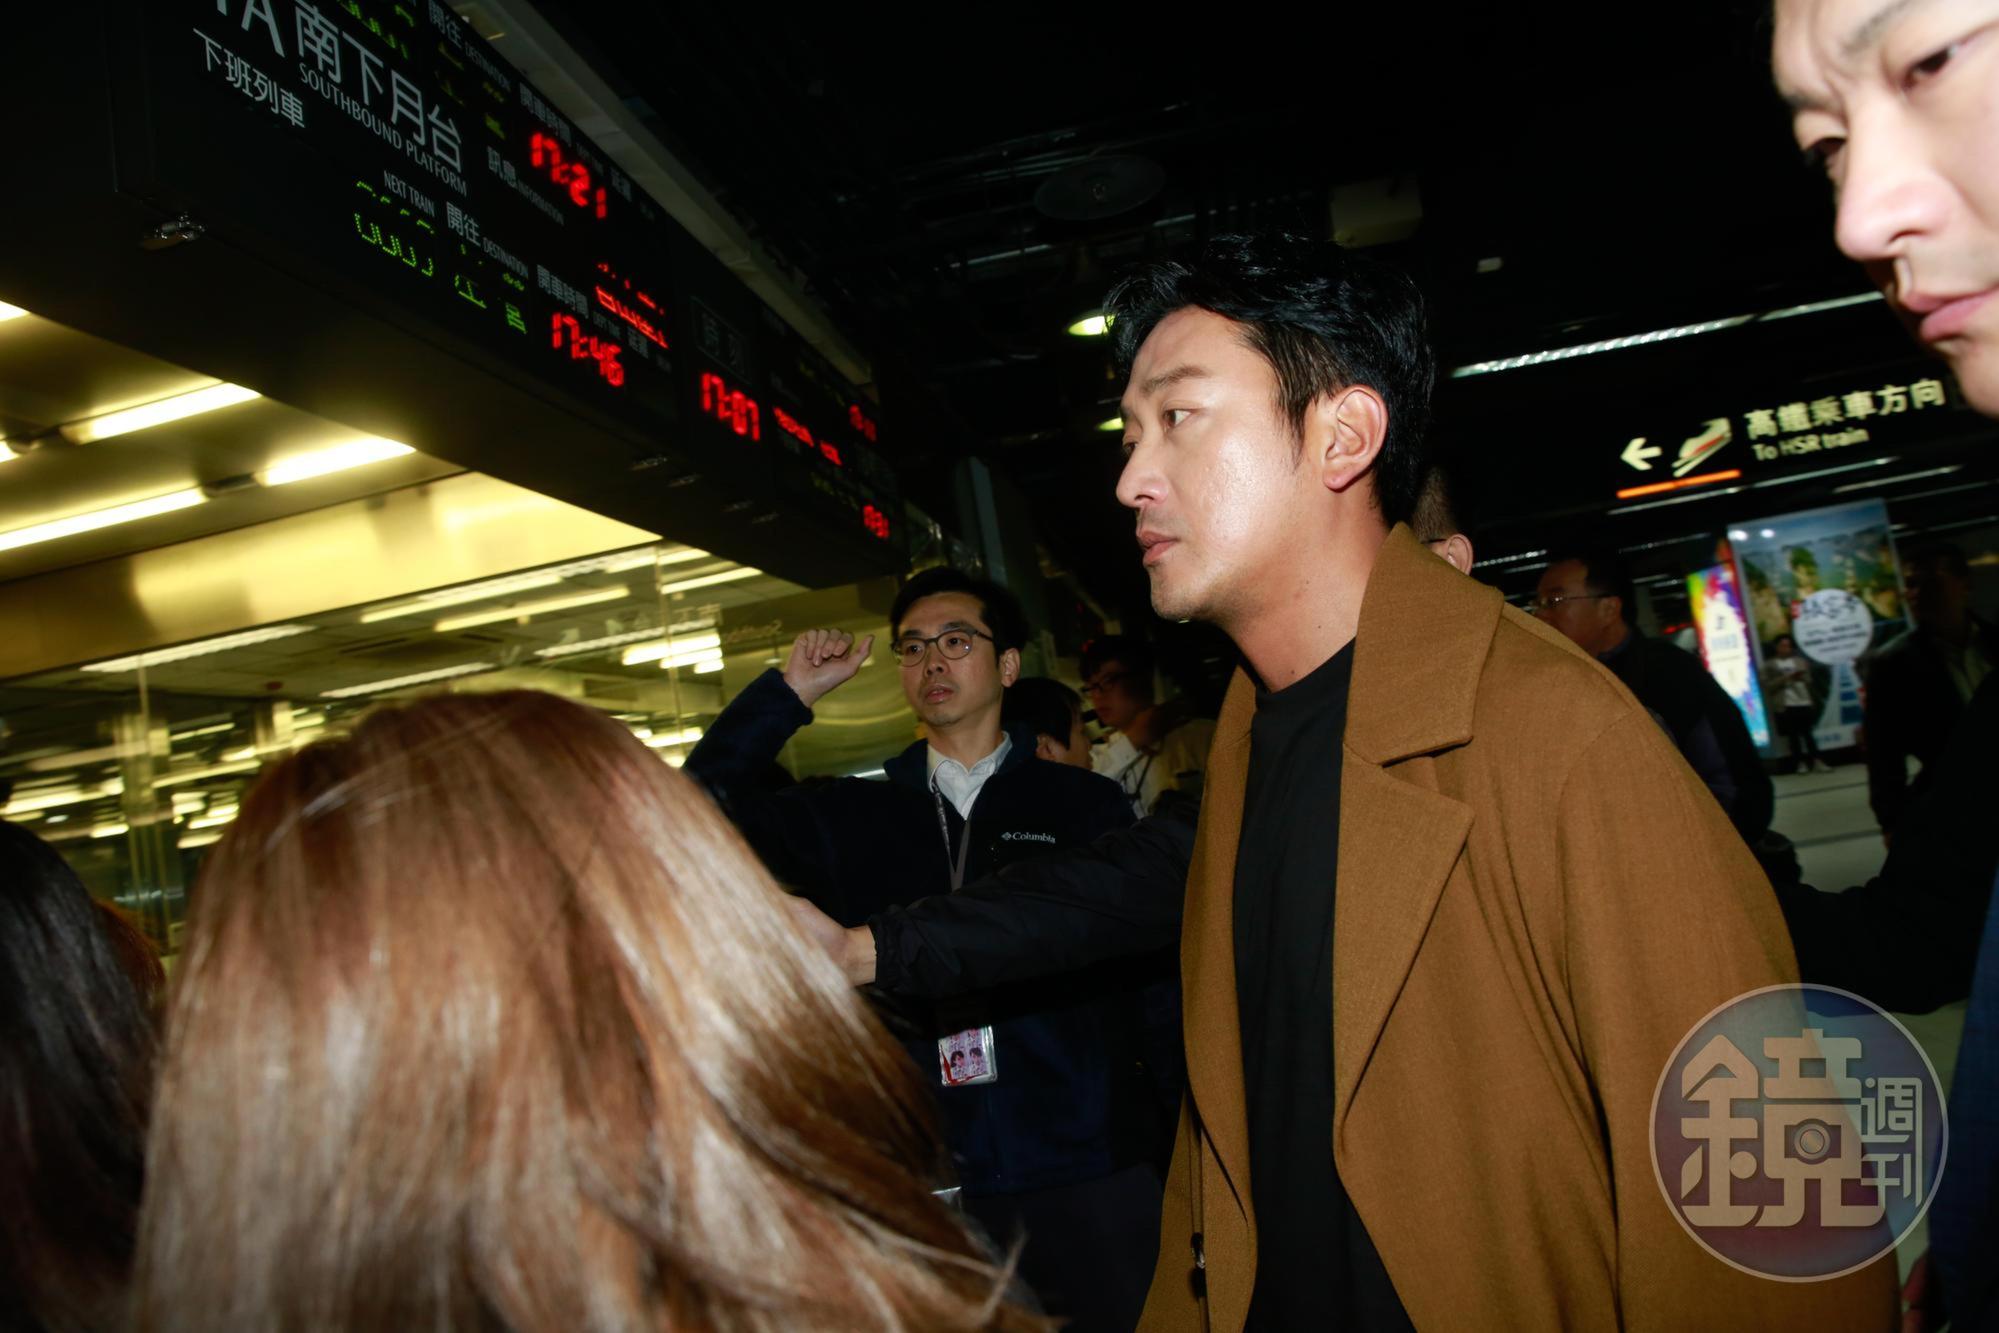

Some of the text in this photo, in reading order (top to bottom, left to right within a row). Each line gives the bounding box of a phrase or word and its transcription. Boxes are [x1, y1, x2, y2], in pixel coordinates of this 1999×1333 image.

[192, 27, 306, 129] 下班列車
[296, 0, 462, 173] 南下月台
[299, 62, 402, 150] SOUTHBOUND
[405, 139, 468, 197] PLATFORM
[383, 169, 436, 218] NEXT TRAIN
[530, 130, 607, 220] 17:21
[446, 200, 482, 248] 開往
[482, 236, 529, 280] DESTINATION
[551, 311, 625, 388] 17:46
[1744, 378, 1946, 440] 高鐵乘車方向
[1752, 426, 1870, 461] To HSR train
[1012, 831, 1056, 844] Columbia
